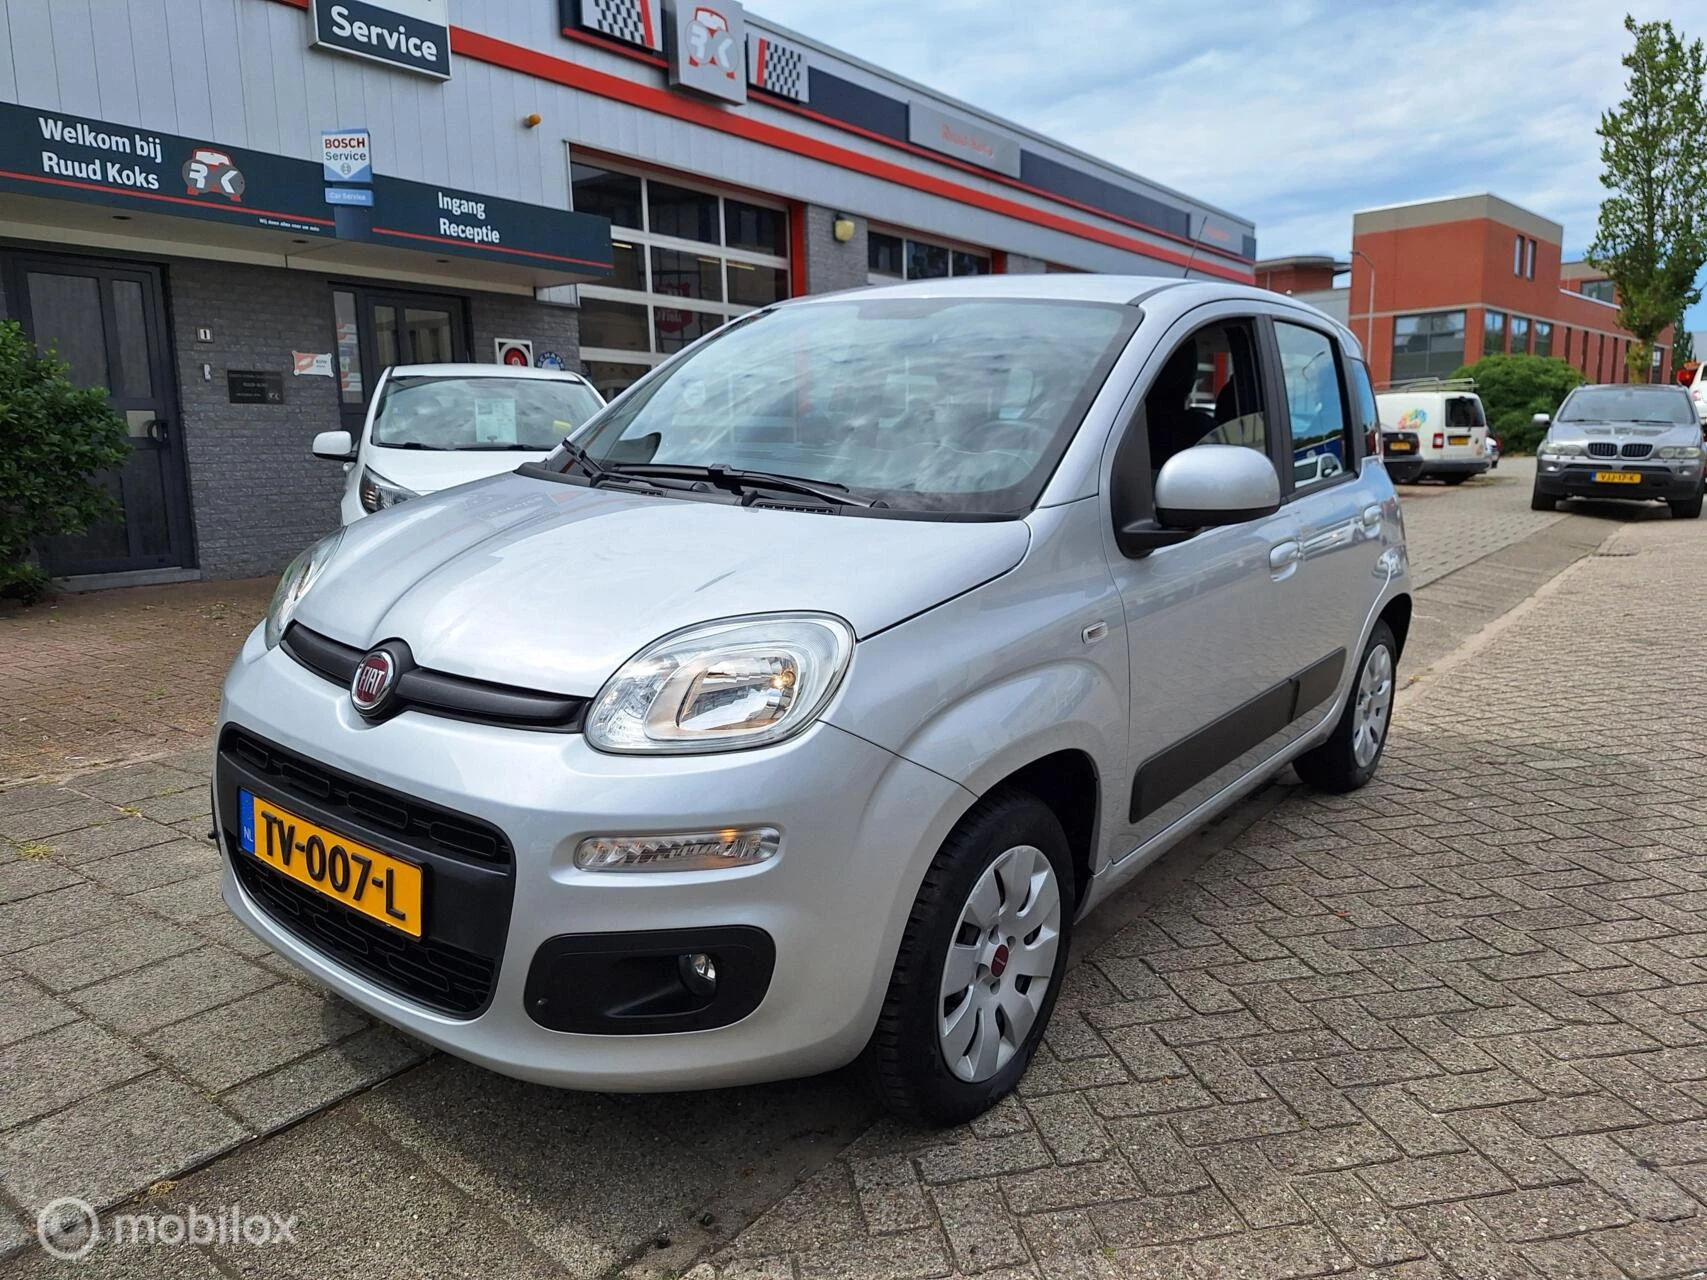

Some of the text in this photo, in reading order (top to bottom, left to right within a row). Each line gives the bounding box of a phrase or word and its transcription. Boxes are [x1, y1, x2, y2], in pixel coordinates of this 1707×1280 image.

[330, 5, 437, 61] Service
[38, 116, 162, 164] Welkom bij
[324, 137, 366, 149] BOSCH
[325, 150, 367, 161] Service
[42, 151, 160, 190] Ruud Koks
[438, 191, 486, 220] Ingang
[439, 217, 500, 243] Receptie
[358, 666, 385, 695] FIAT
[243, 825, 254, 843] NL
[261, 810, 406, 921] TV-007-L
